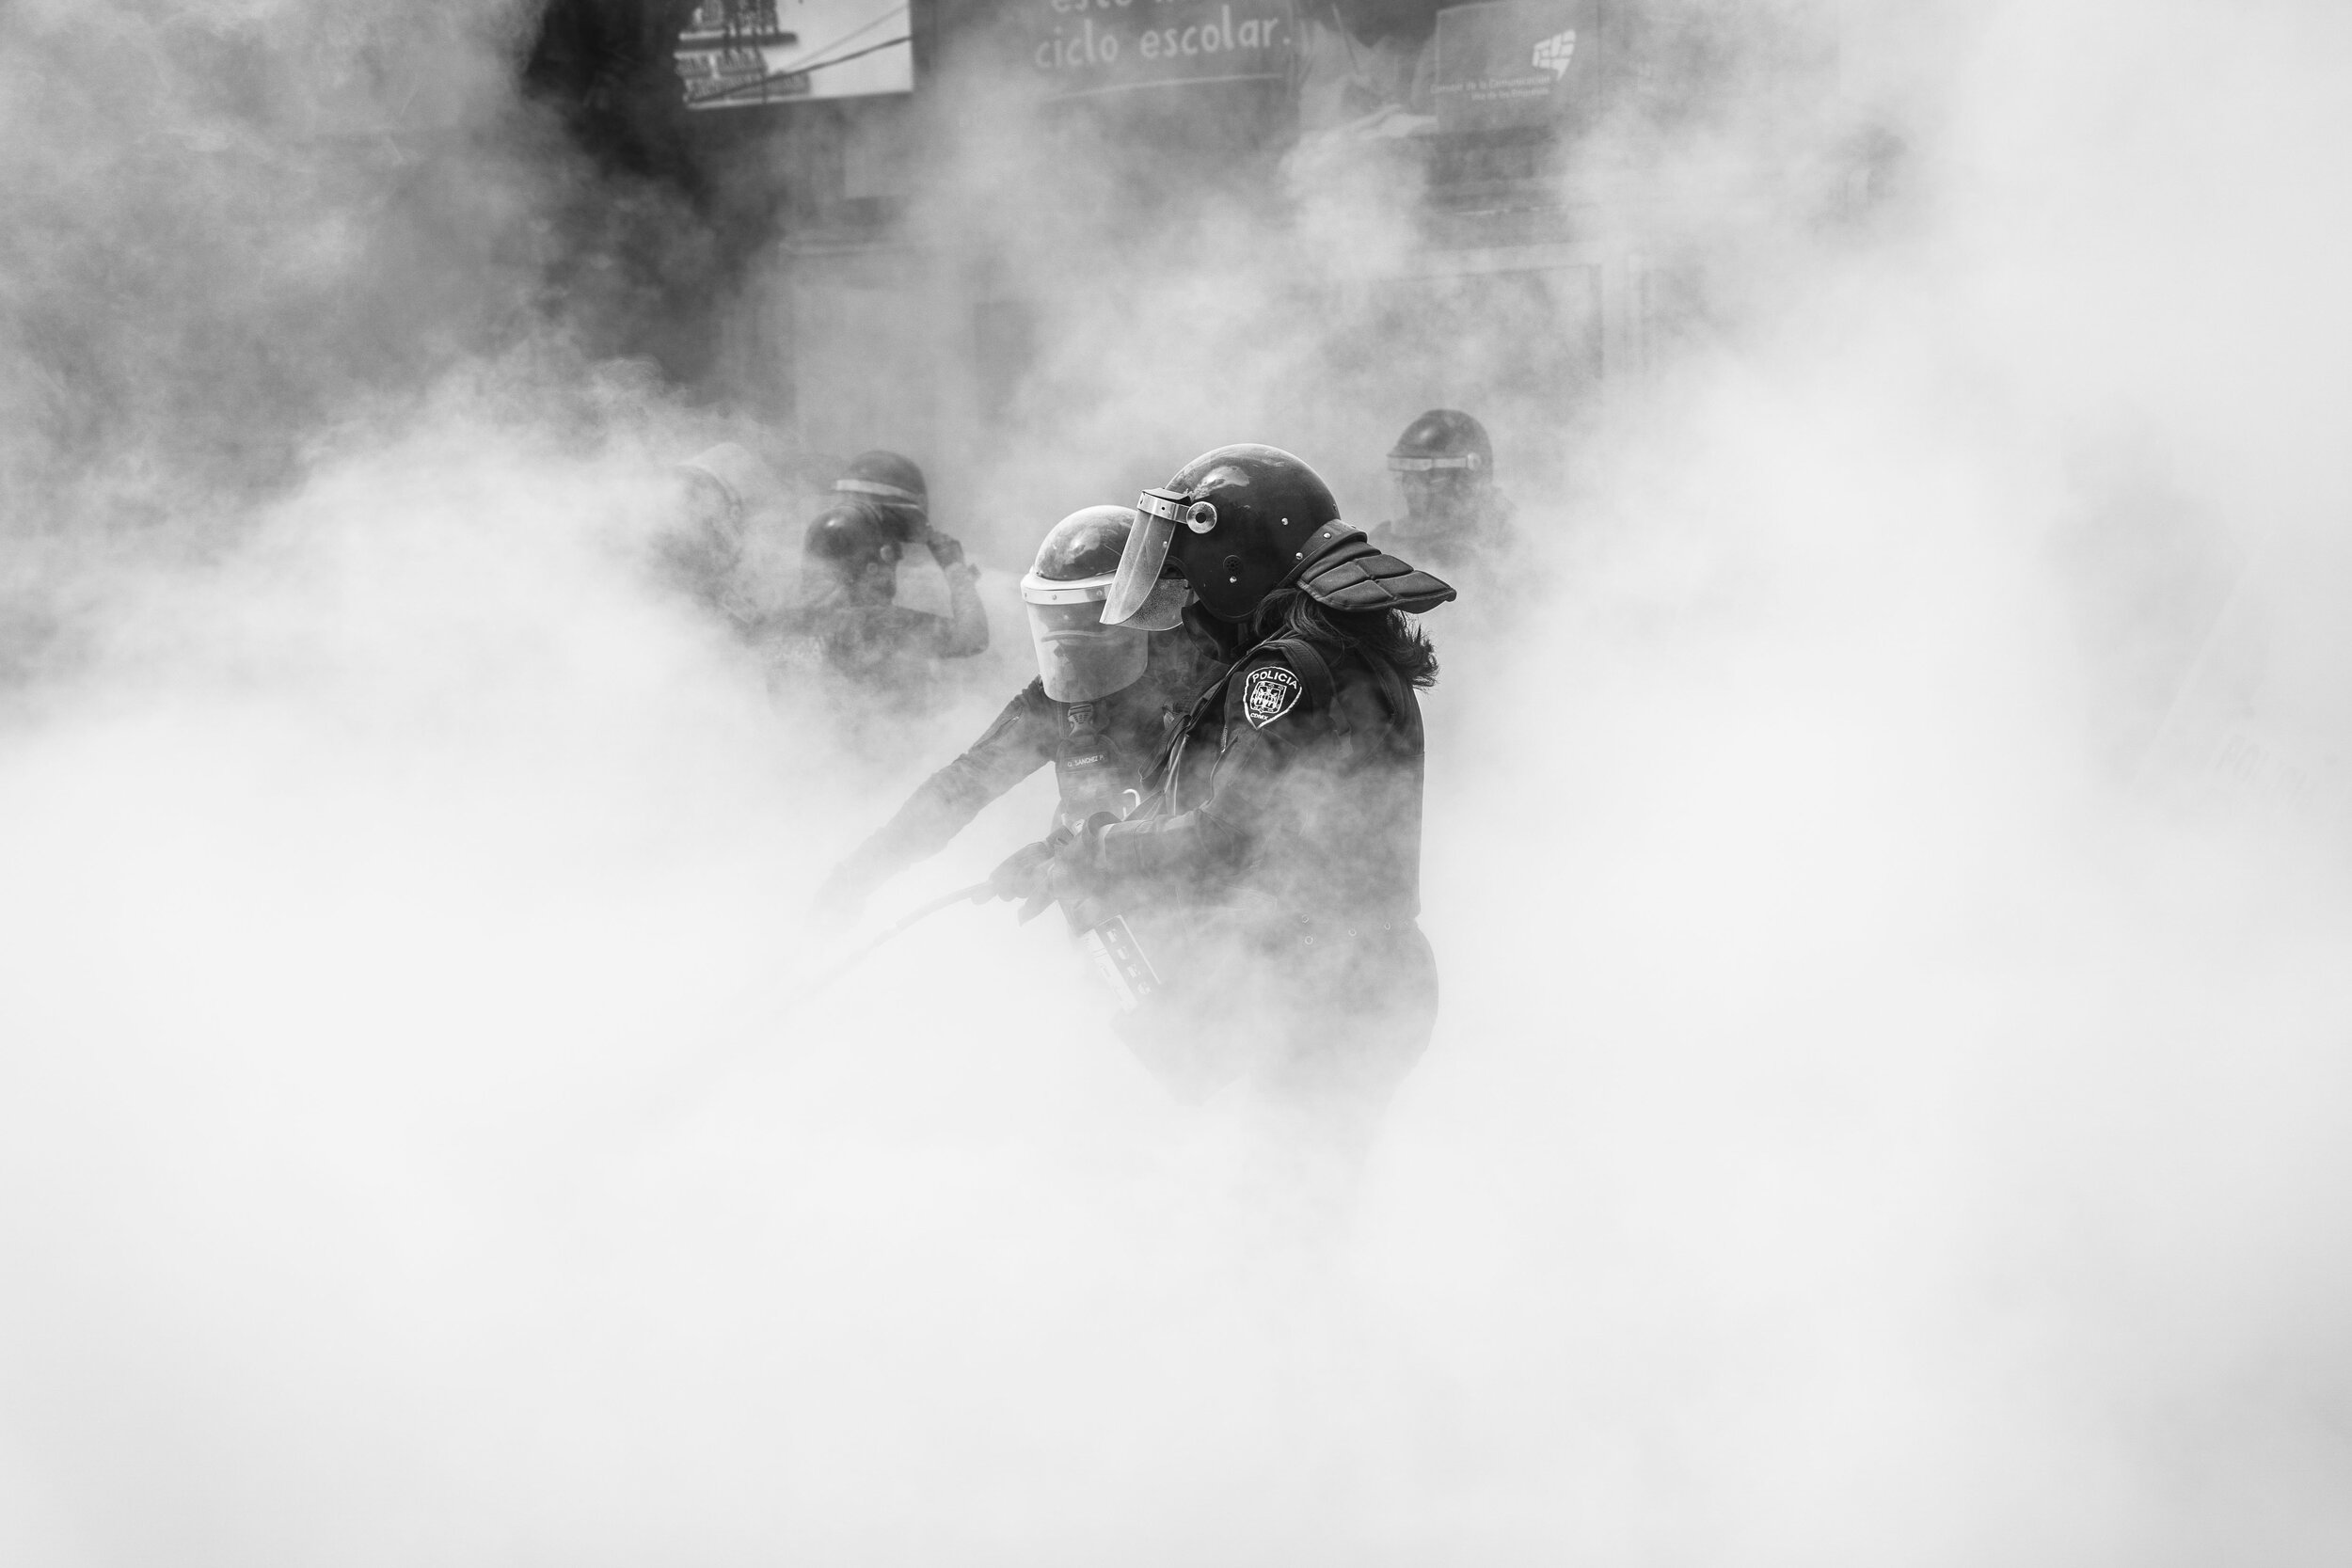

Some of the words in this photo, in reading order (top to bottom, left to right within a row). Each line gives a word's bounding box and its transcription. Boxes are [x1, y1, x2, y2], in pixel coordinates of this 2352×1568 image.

[1035, 18, 1119, 69] ciclo
[1140, 4, 1292, 59] escolar.
[1251, 670, 1297, 689] POLICIA
